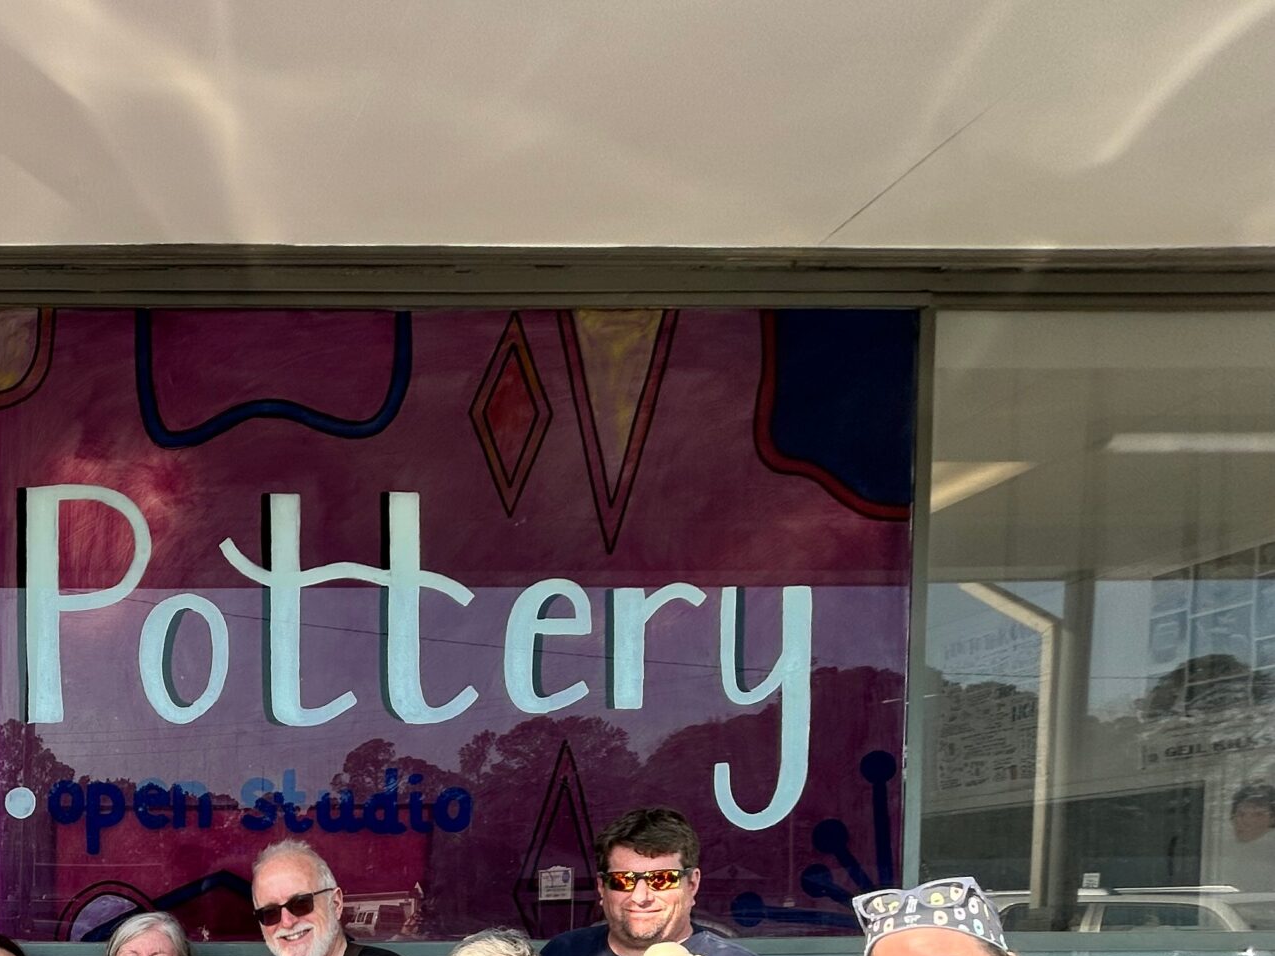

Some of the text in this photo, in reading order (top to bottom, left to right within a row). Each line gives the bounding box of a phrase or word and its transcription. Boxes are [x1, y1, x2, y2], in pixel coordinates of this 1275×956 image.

[21, 484, 812, 830] Pottery
[47, 768, 474, 855] open studio
